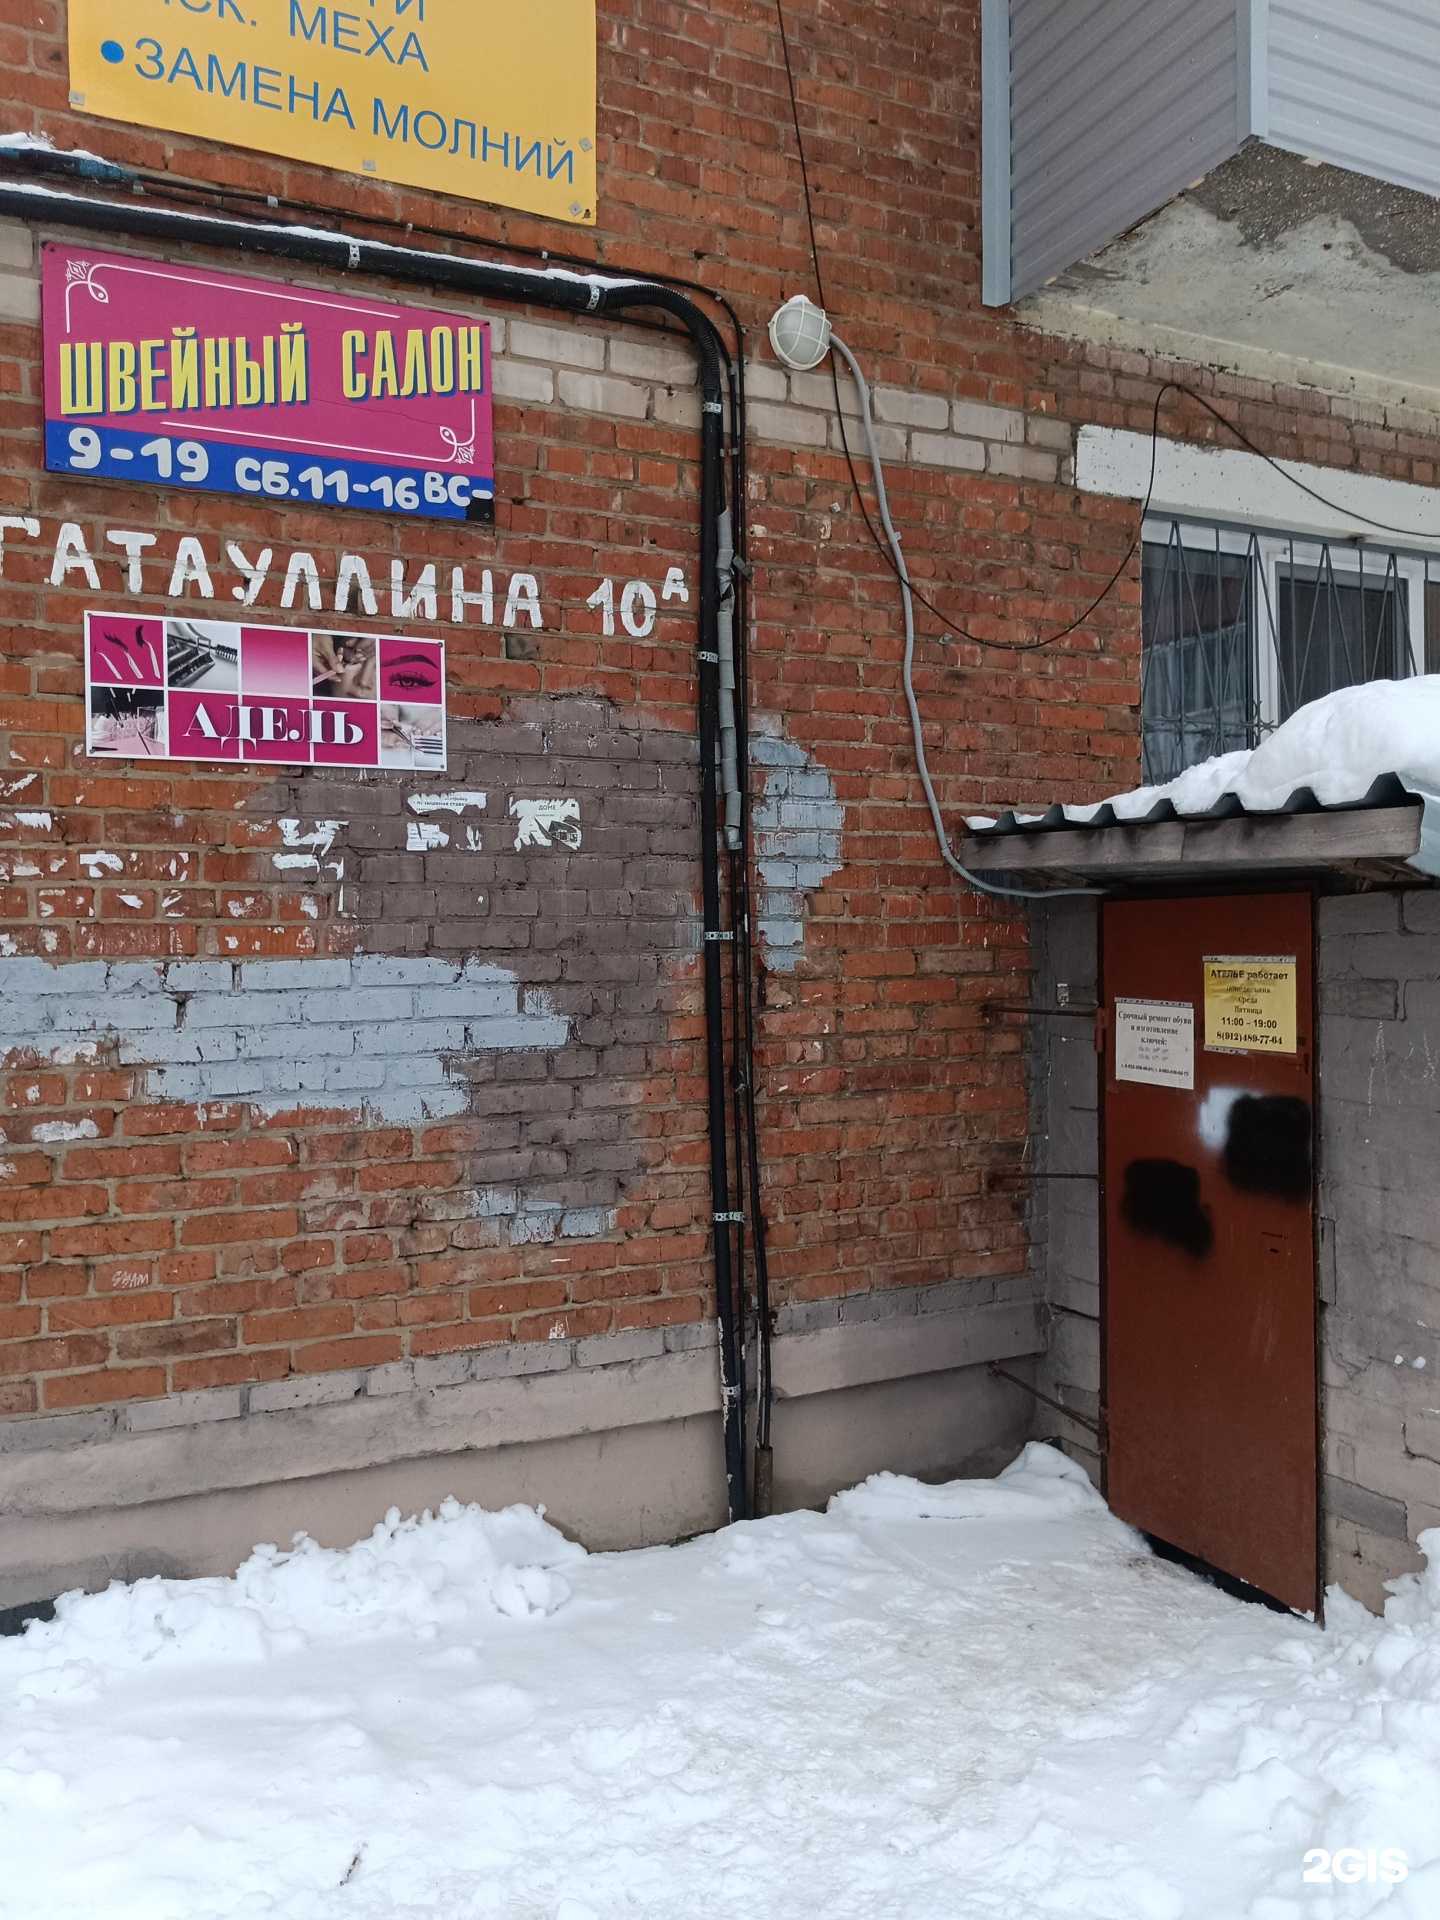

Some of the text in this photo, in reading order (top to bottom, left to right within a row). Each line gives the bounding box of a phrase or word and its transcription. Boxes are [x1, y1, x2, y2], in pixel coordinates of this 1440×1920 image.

[289, 0, 430, 72] МЕХА
[134, 37, 575, 184] ЗАМЕНА МОЛНИЙ
[59, 321, 484, 417] ШВЕЙНЫЙ САЛОН
[68, 427, 210, 483] 9-19
[0, 514, 544, 629] ГАТАУЛЛИНА
[181, 701, 365, 752] АДЕЛЬ
[1246, 970, 1289, 981] работает
[1118, 1010, 1192, 1026] Срочный ремонт обуви
[1221, 1017, 1244, 1026] 11:00
[1253, 1018, 1278, 1029] 19:00
